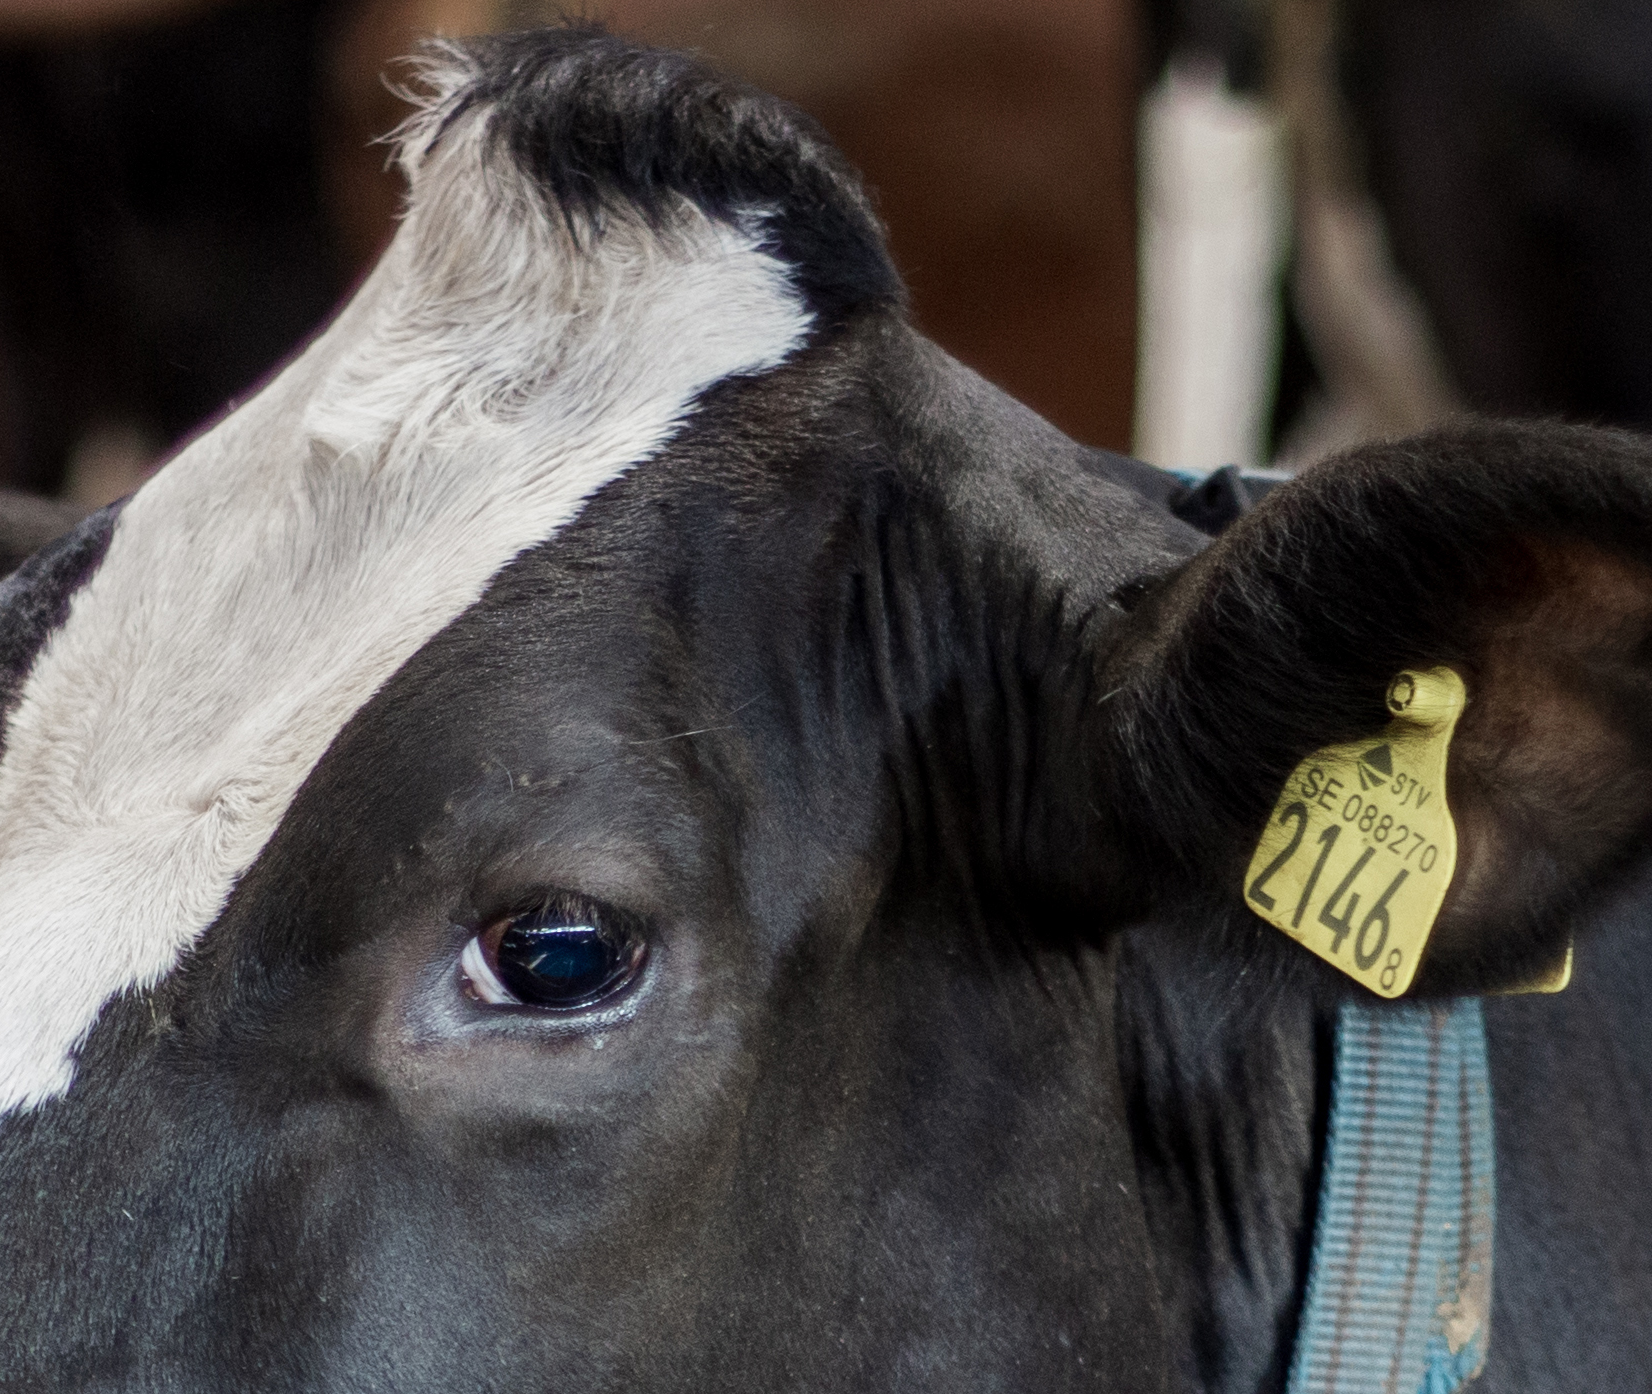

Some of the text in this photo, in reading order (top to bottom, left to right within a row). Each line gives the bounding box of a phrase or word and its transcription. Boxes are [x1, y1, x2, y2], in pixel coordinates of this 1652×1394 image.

[1302, 768, 1438, 873] SE 088270
[1391, 773, 1432, 809] SJV
[1247, 802, 1409, 991] 2146 8
